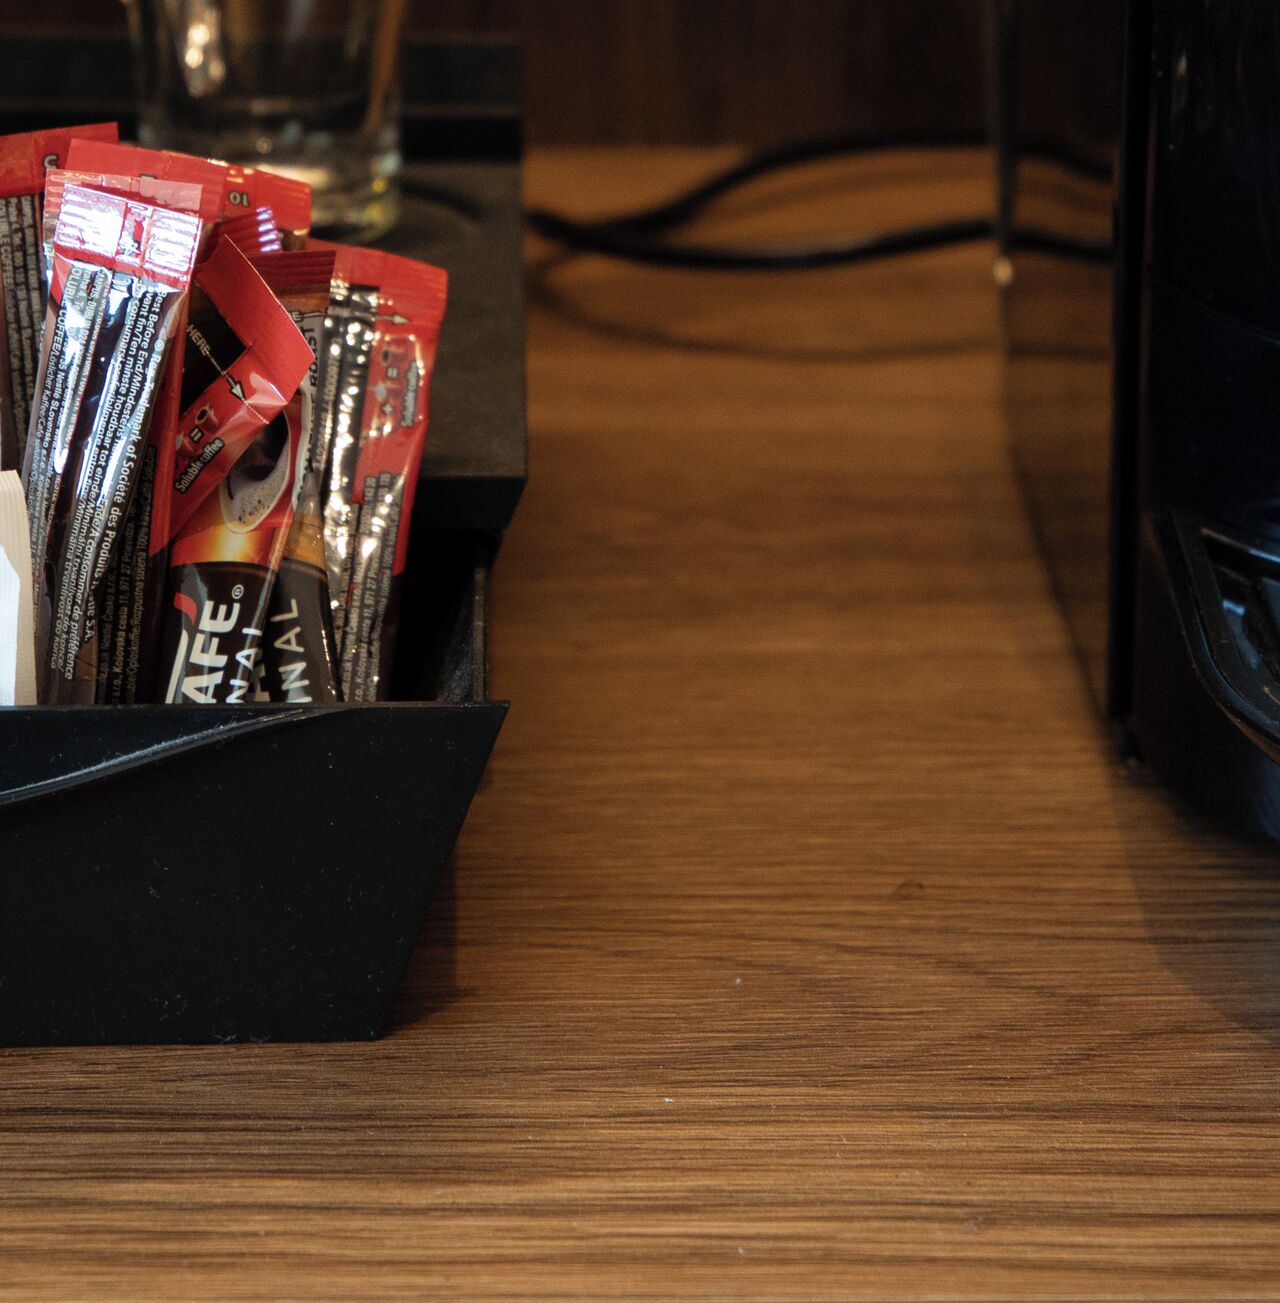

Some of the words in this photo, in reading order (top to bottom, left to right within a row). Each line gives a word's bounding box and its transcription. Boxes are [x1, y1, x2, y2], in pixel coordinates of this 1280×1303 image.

[81, 300, 96, 328] DUBLIN
[139, 285, 155, 316] vant
[151, 290, 167, 313] Best
[128, 316, 146, 355] fin/Ten
[140, 312, 158, 349] Before
[183, 323, 213, 357] HERE
[117, 356, 136, 394] minste
[300, 326, 317, 386] ROST
[52, 370, 66, 399] Nestlé
[115, 350, 149, 438] End/Mindestens
[35, 388, 51, 437] Kaffee/Café
[42, 400, 59, 448] SLovensko
[102, 394, 126, 448] houdbaar
[129, 379, 154, 442] Trademark
[97, 448, 109, 466] tot
[124, 444, 138, 459] of
[173, 457, 205, 493] Soluble
[196, 435, 224, 464] coffee
[112, 459, 135, 504] Société
[73, 467, 105, 556] einde/Minimální
[106, 506, 122, 528] des
[73, 538, 96, 603] consommer
[94, 529, 116, 579] Produits
[56, 560, 73, 618] trvanlivost
[63, 557, 81, 614] trvanlivost
[54, 619, 63, 635] do
[61, 615, 70, 632] do
[71, 605, 84, 619] de
[83, 617, 95, 643] S.A.
[49, 635, 60, 669] konca
[56, 633, 68, 671] konce/
[62, 620, 80, 680] préférence
